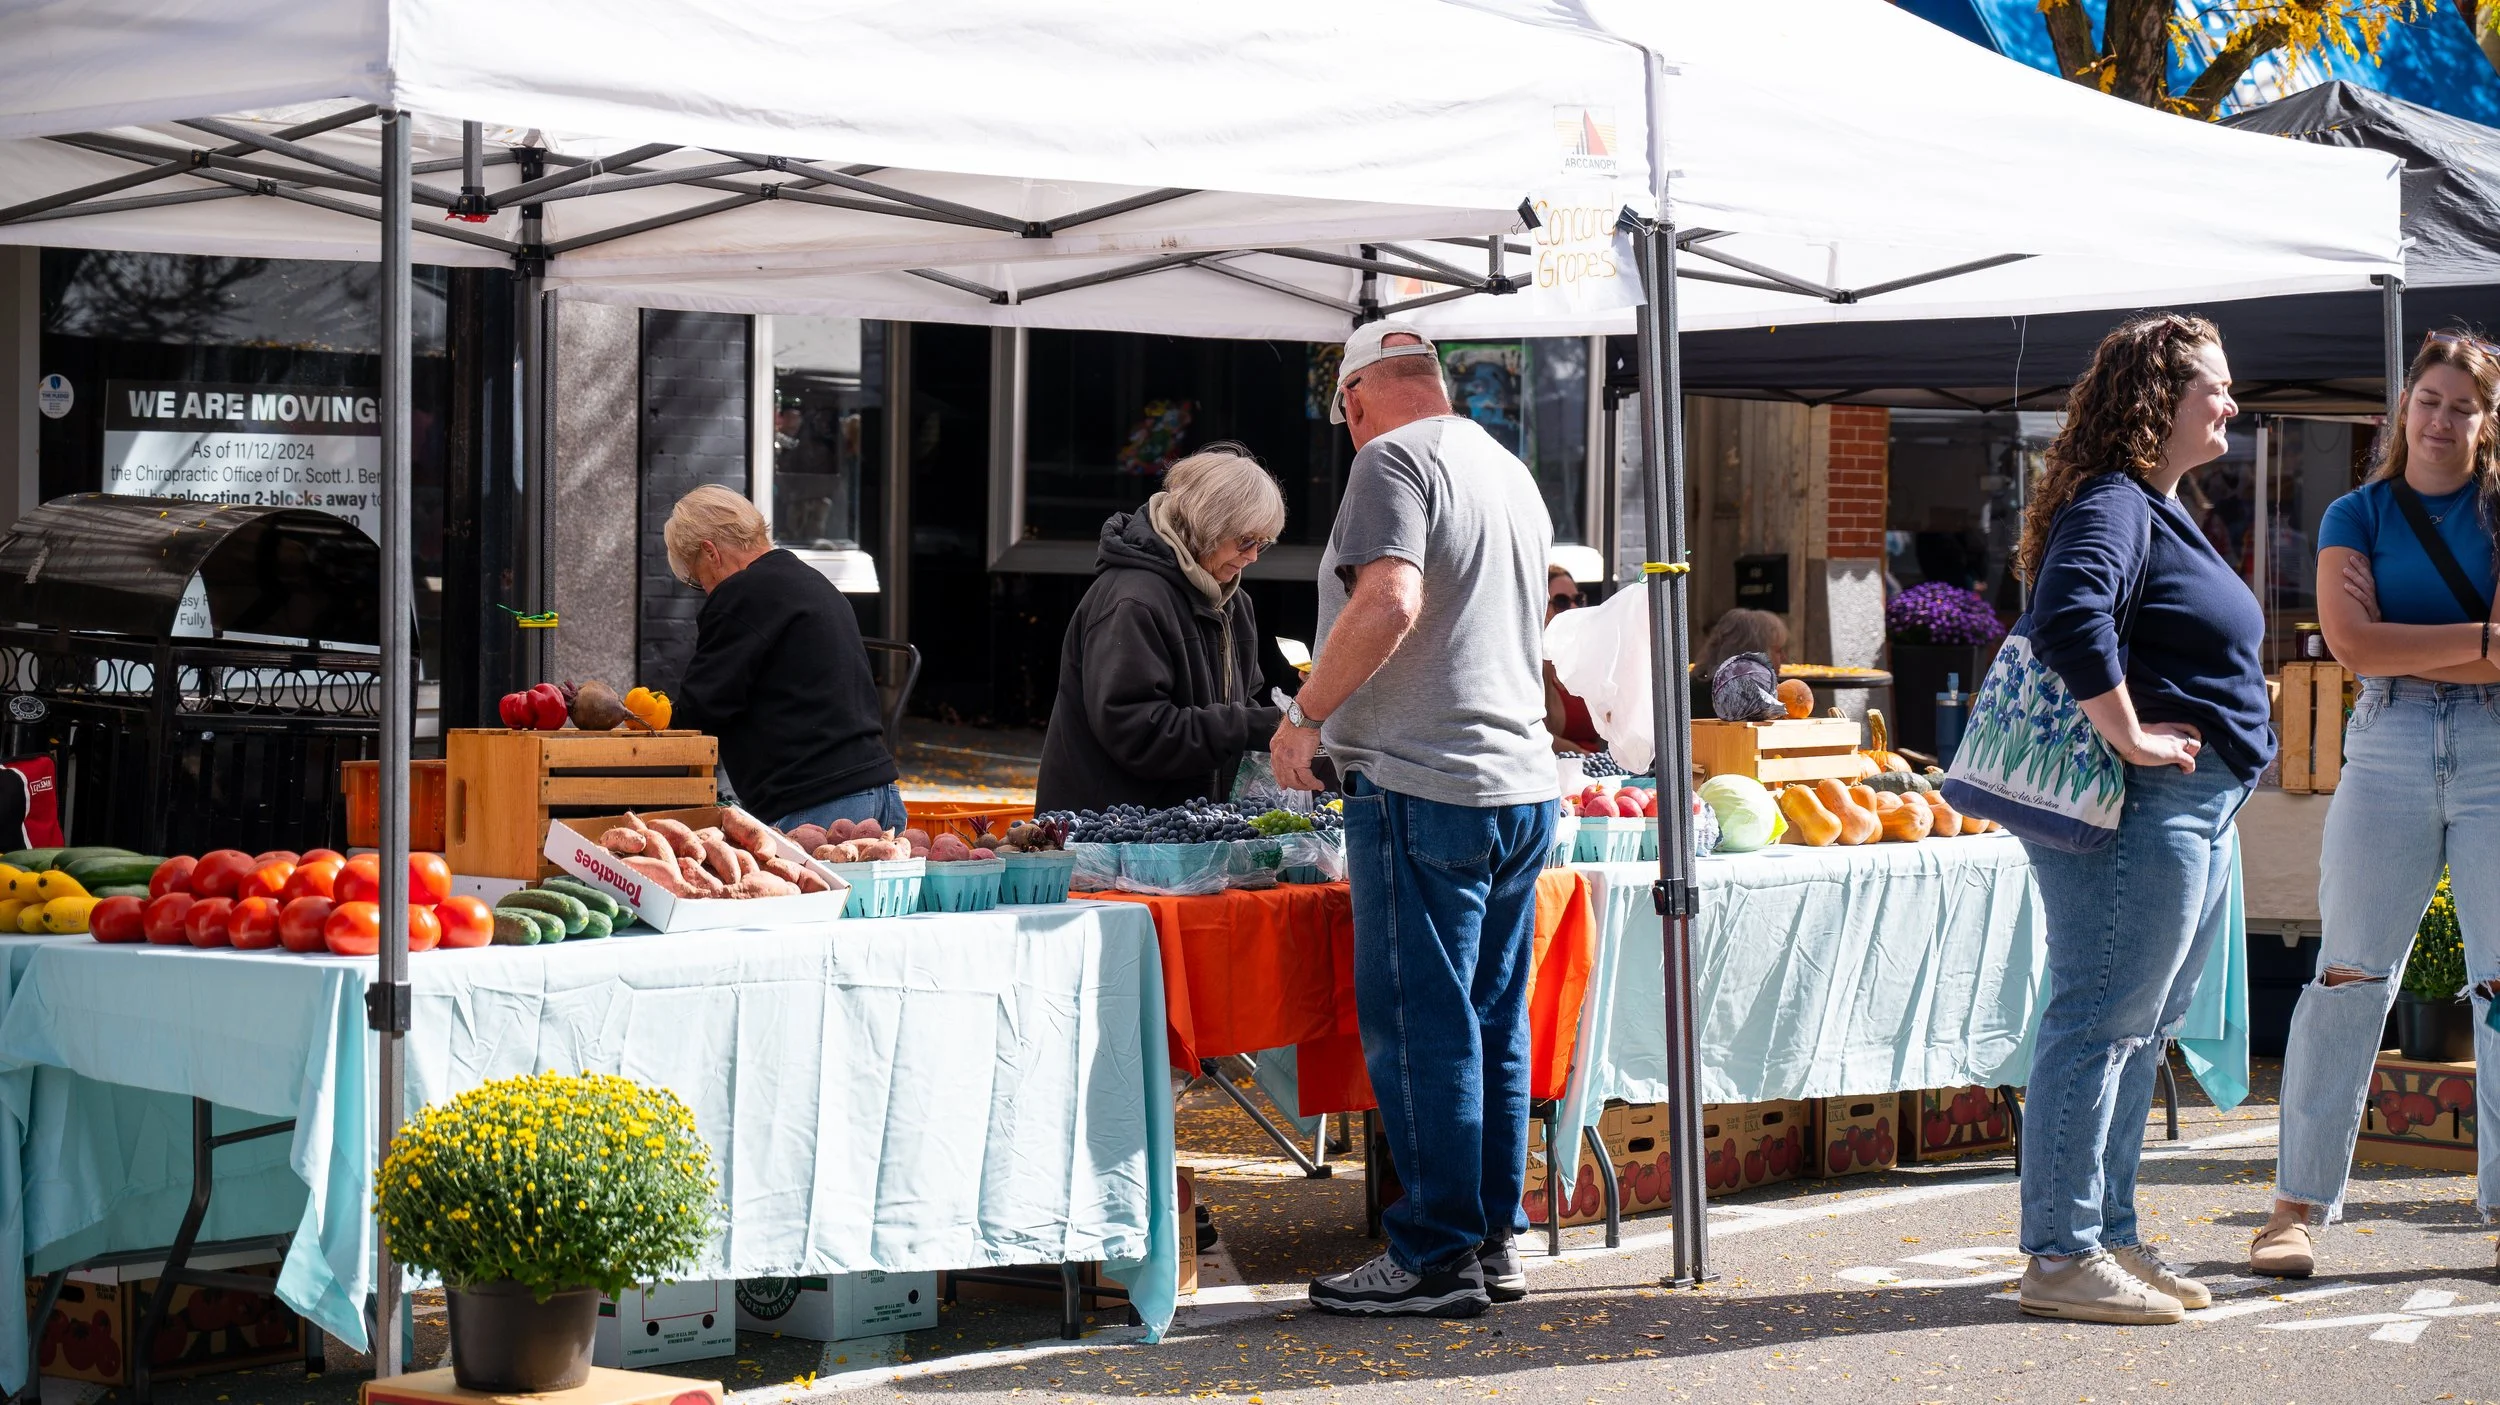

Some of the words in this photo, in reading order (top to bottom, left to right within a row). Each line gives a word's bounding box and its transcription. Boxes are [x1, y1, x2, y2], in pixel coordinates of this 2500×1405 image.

[1564, 157, 1617, 170] ABCCANOPY
[1534, 192, 1616, 246] Concord
[128, 390, 176, 418] WE
[180, 391, 244, 421] ARE
[191, 441, 211, 459] As
[216, 441, 231, 459] of
[235, 441, 315, 461] 11/12/2024
[111, 464, 132, 481] the
[136, 464, 219, 485] Chiropractic
[222, 466, 263, 483] Office
[266, 466, 280, 483] of
[283, 467, 302, 484] Dr.
[305, 467, 341, 484] Scott
[345, 468, 354, 484] J.
[255, 490, 322, 507] 2-blocks
[326, 493, 367, 510] away
[181, 596, 200, 610] asy
[180, 612, 207, 628] Fully
[2031, 795, 2060, 809] Boston
[574, 848, 642, 908] Tomatoes
[736, 1282, 795, 1316] VEGETABLES
